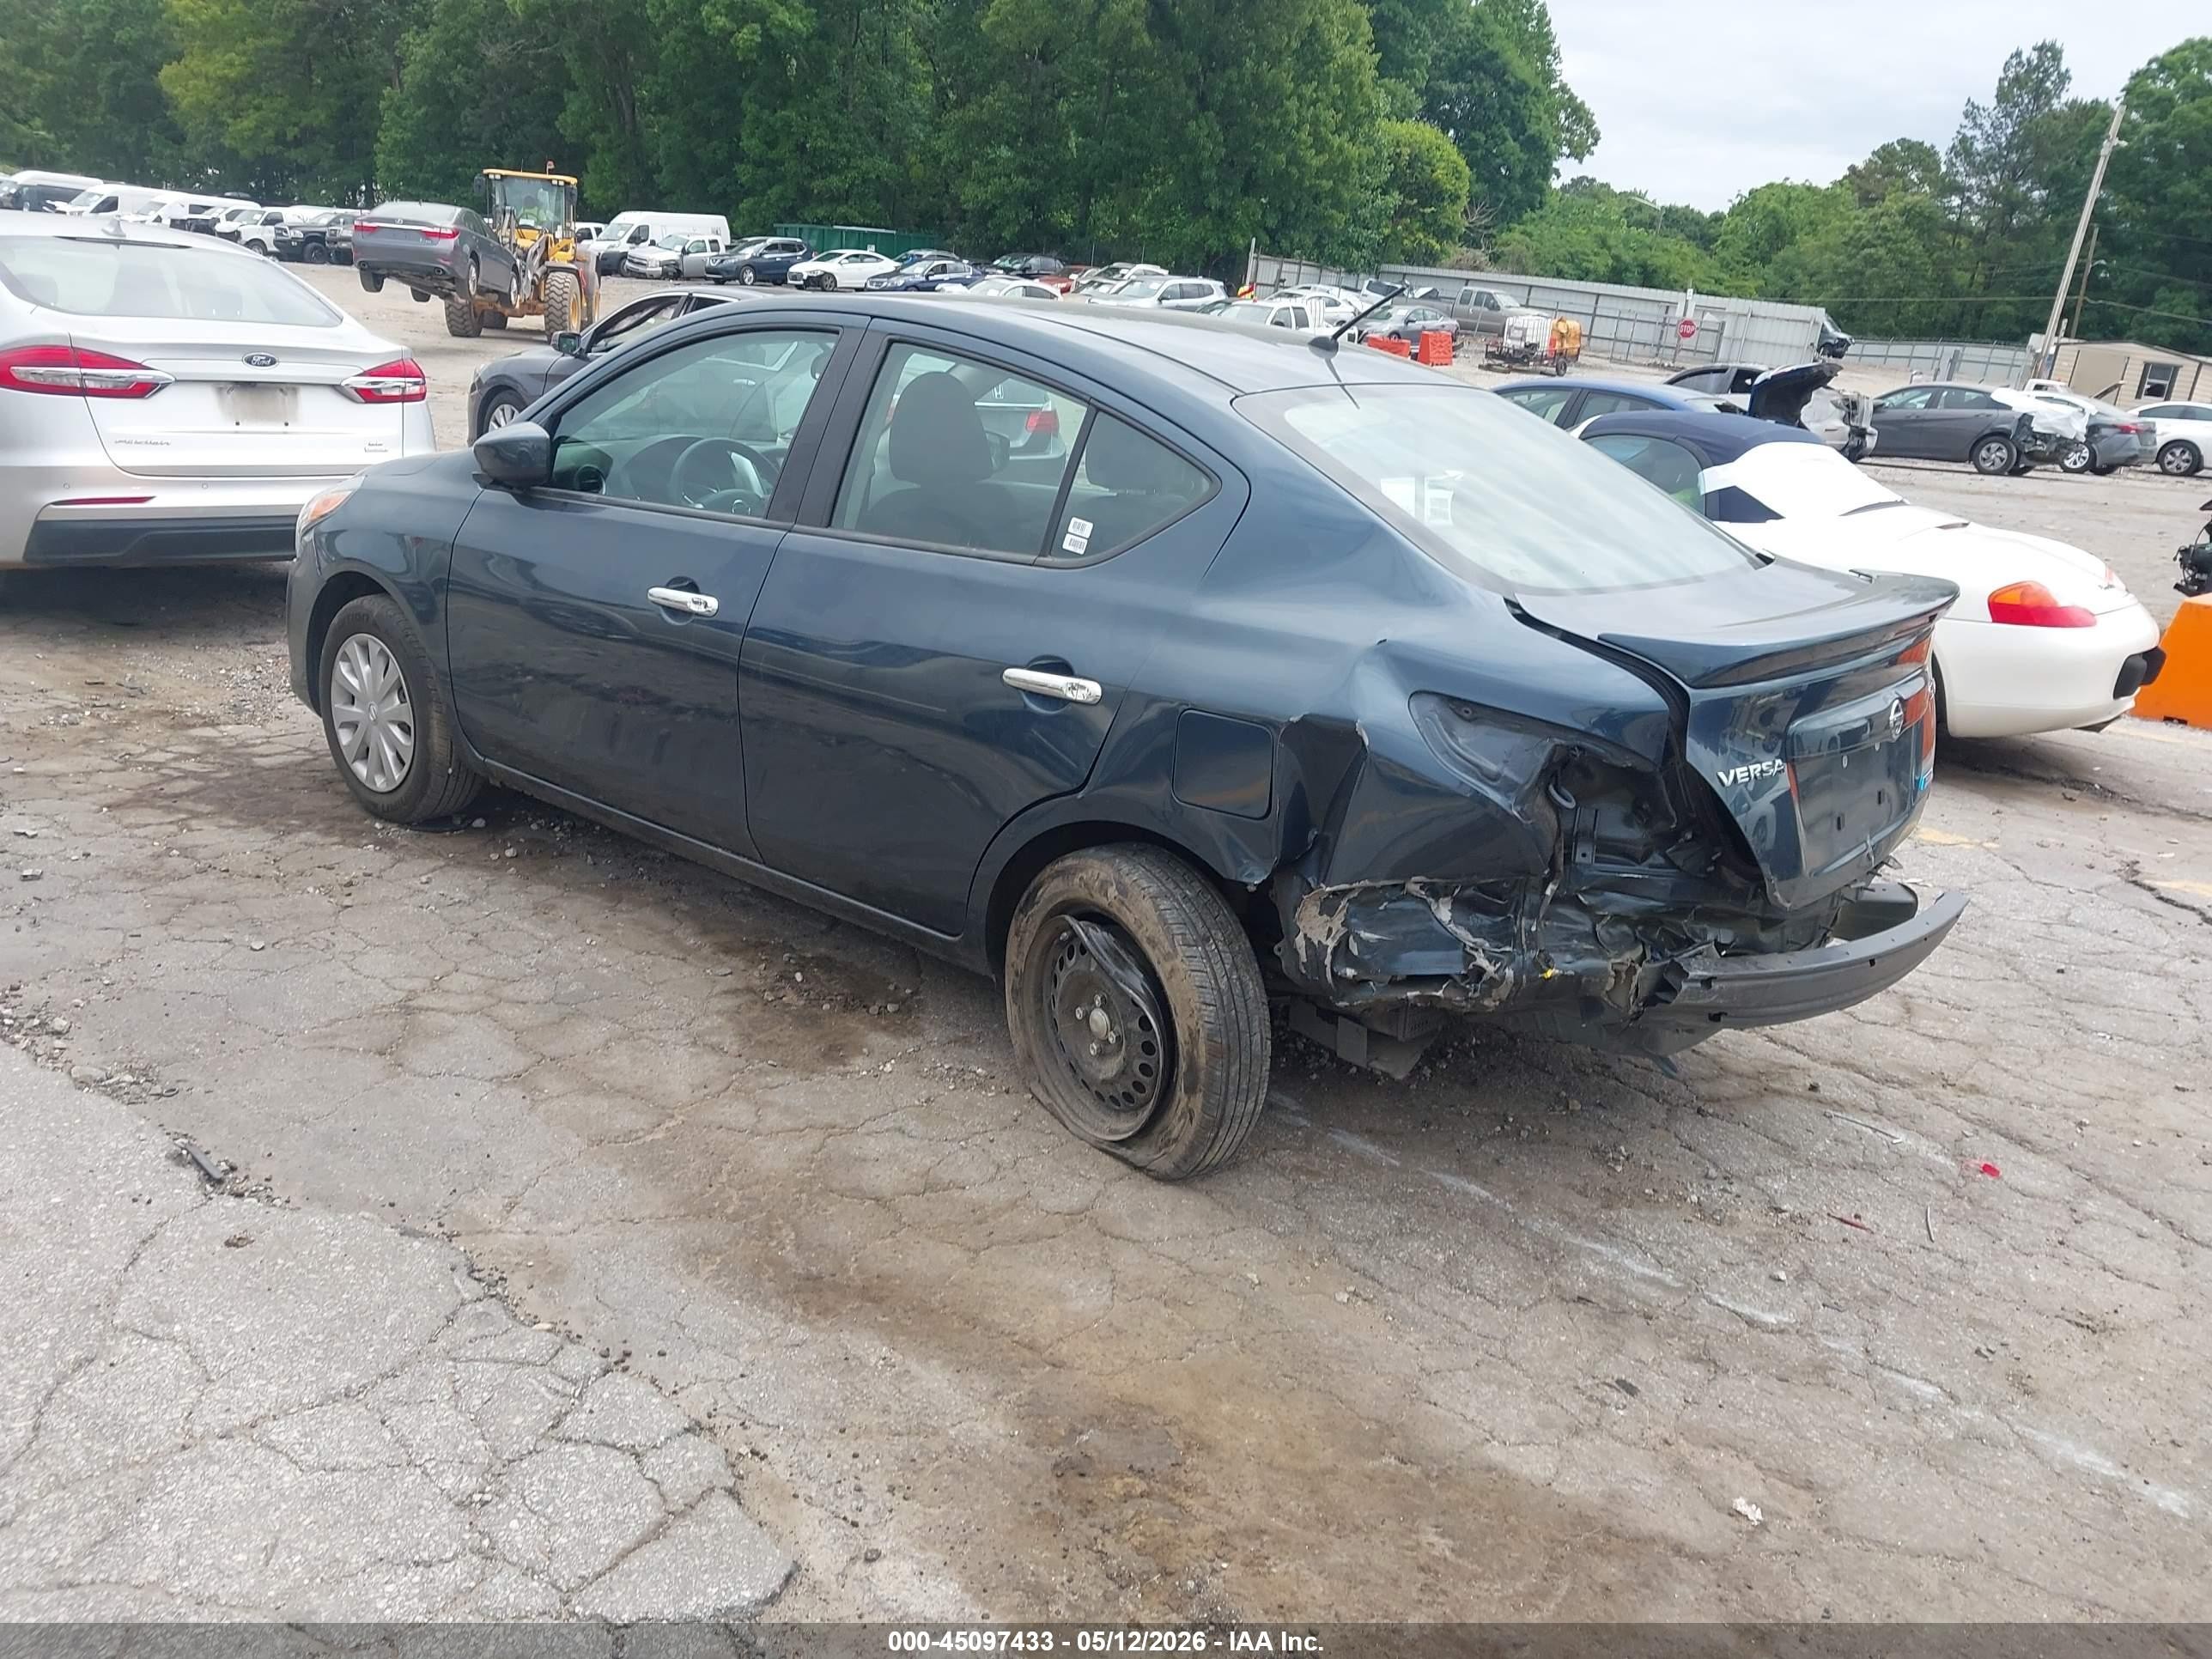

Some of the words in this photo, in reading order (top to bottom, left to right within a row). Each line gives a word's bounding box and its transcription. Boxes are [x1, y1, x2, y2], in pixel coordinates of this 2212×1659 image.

[1679, 325, 1695, 333] STOP
[251, 355, 271, 366] Ford
[1717, 758, 1784, 787] VERSA
